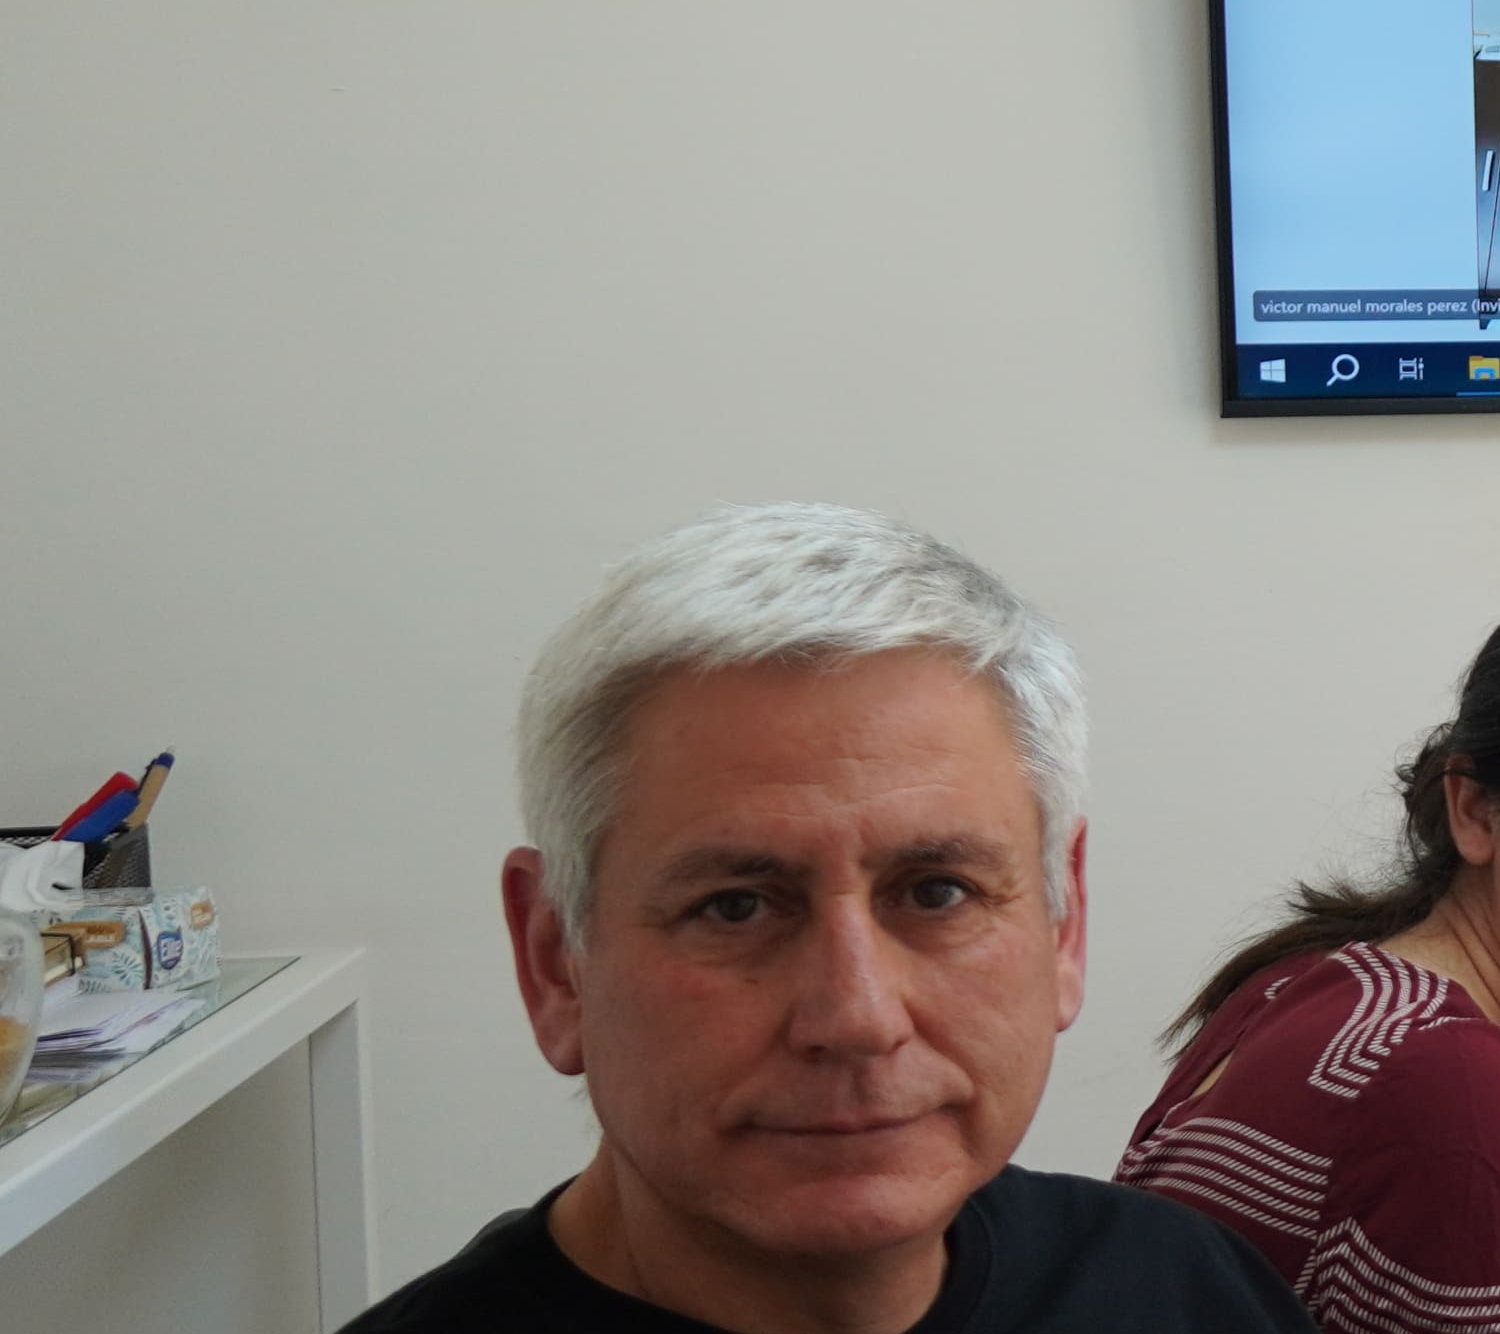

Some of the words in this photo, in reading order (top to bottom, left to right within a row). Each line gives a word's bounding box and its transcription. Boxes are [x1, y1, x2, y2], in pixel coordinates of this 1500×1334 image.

[1261, 300, 1303, 314] victor
[1307, 300, 1361, 313] manuel
[1366, 300, 1423, 313] morales
[1428, 302, 1467, 315] perez
